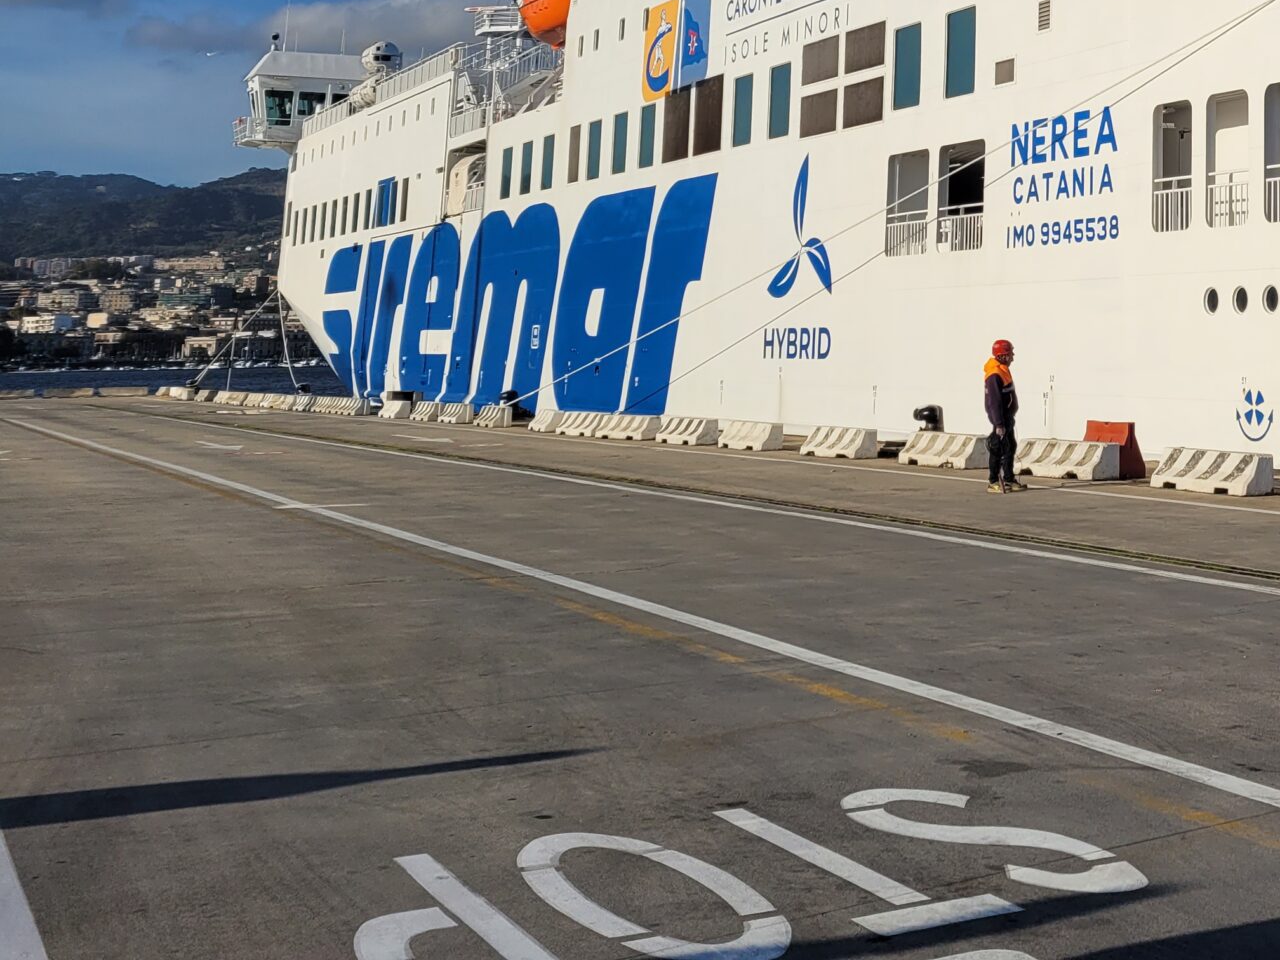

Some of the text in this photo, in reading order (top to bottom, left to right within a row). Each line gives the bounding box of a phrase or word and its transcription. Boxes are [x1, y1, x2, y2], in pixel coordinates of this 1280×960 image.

[724, 3, 850, 66] ISOLE MINORI
[1010, 106, 1118, 168] NEREA
[1012, 163, 1114, 204] CATANIA
[1006, 214, 1120, 248] IMO 9945538
[763, 327, 832, 360] HYBRID
[353, 788, 1149, 960] STOP
